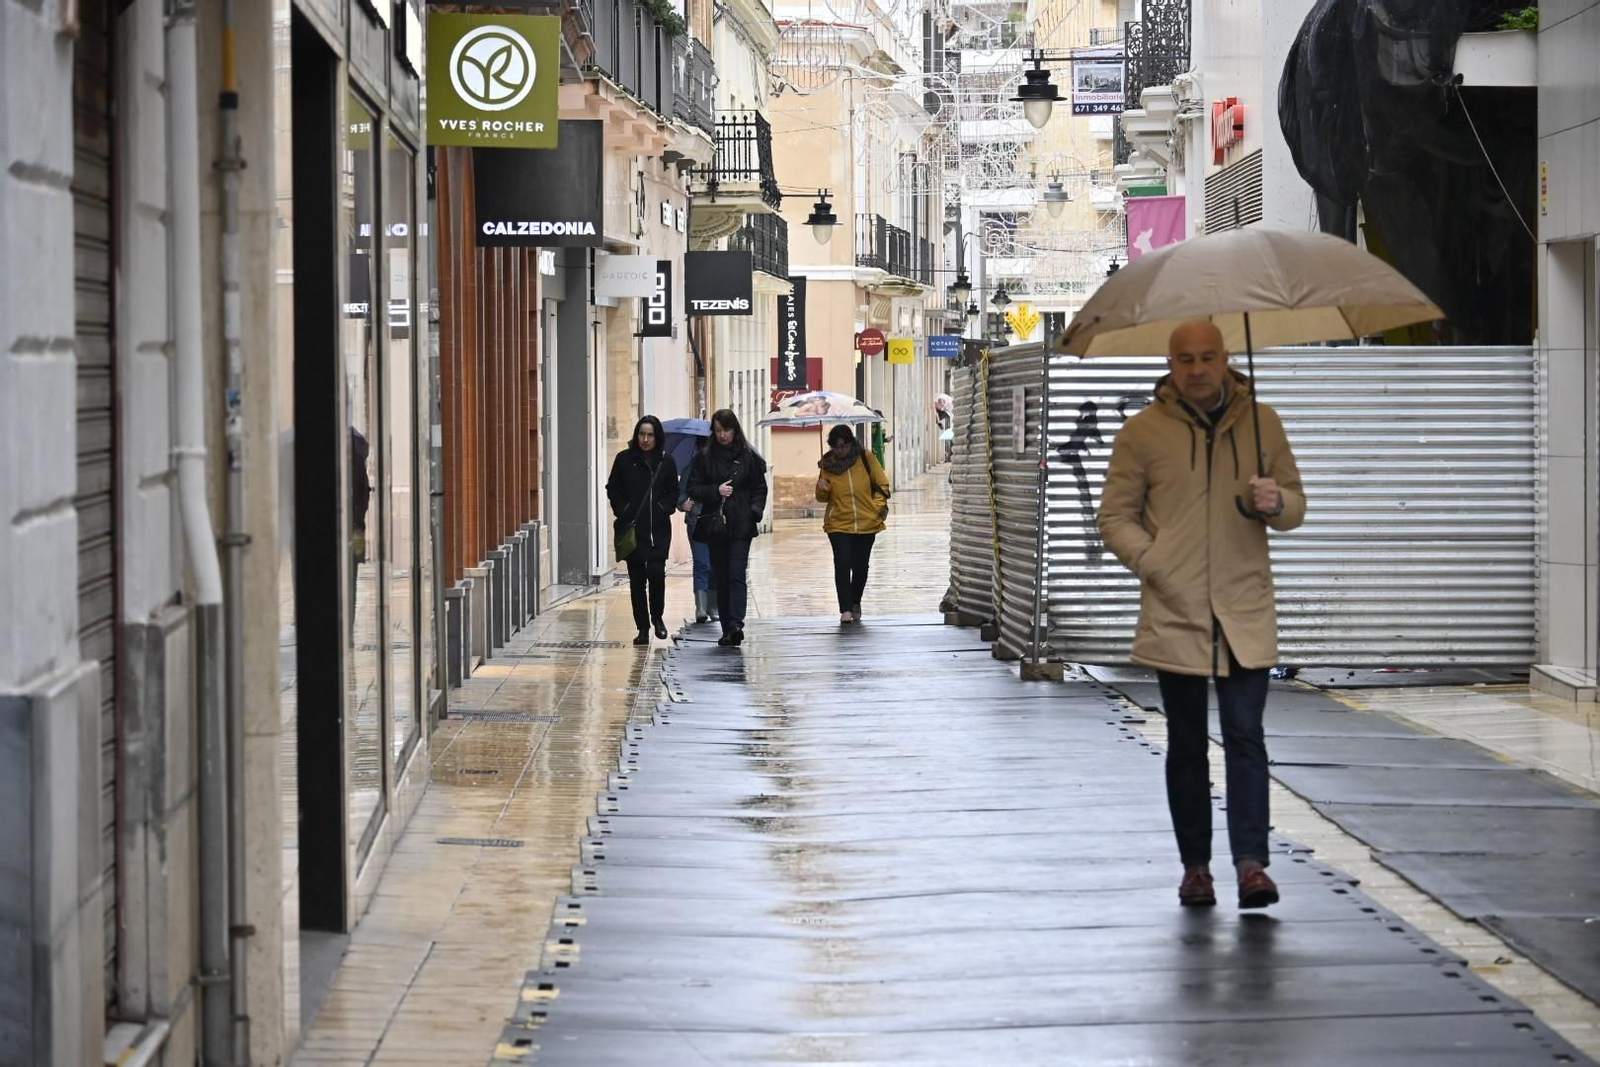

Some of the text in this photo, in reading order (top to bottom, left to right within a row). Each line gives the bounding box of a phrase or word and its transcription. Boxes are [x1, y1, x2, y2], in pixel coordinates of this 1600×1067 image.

[1075, 104, 1090, 112] 671
[1093, 104, 1108, 112] 349
[439, 119, 544, 132] YVES ROCHER
[482, 221, 596, 236] CALZEDONIA
